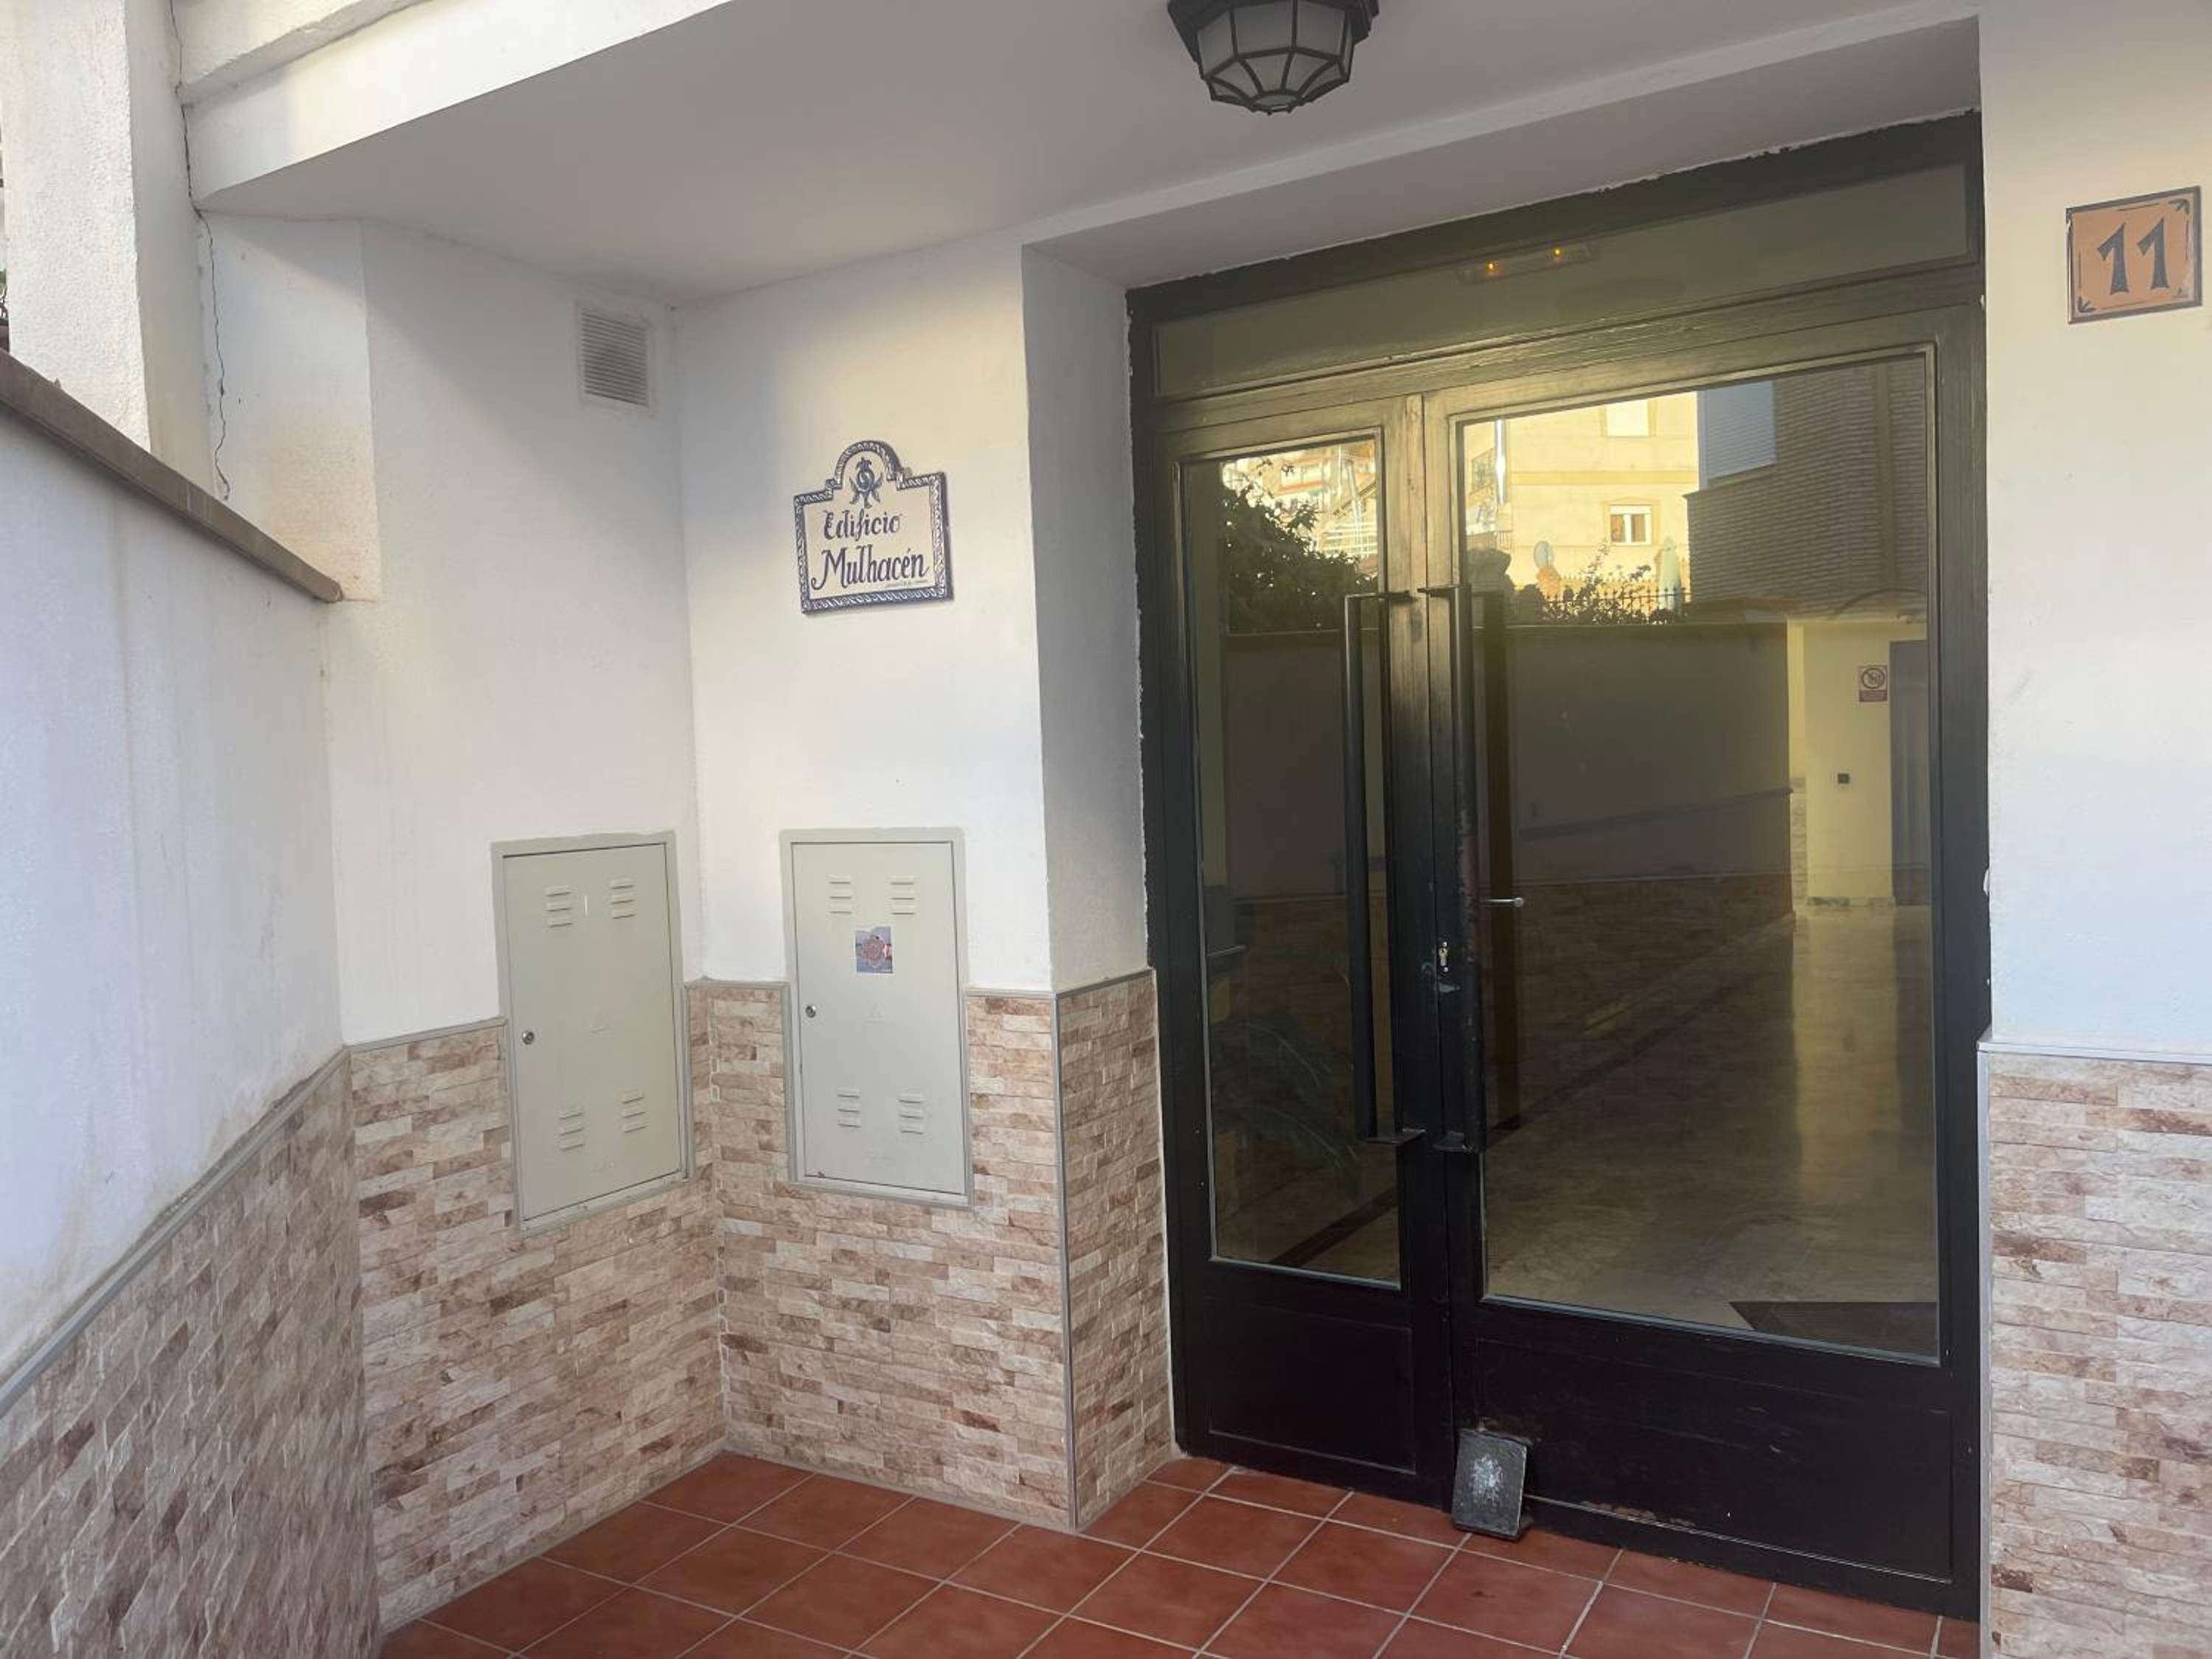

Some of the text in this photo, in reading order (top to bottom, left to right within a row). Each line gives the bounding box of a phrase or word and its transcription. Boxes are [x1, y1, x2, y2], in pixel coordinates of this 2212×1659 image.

[2097, 217, 2170, 295] 11
[823, 508, 902, 541] Edificio
[811, 544, 930, 590] Mulhacén
